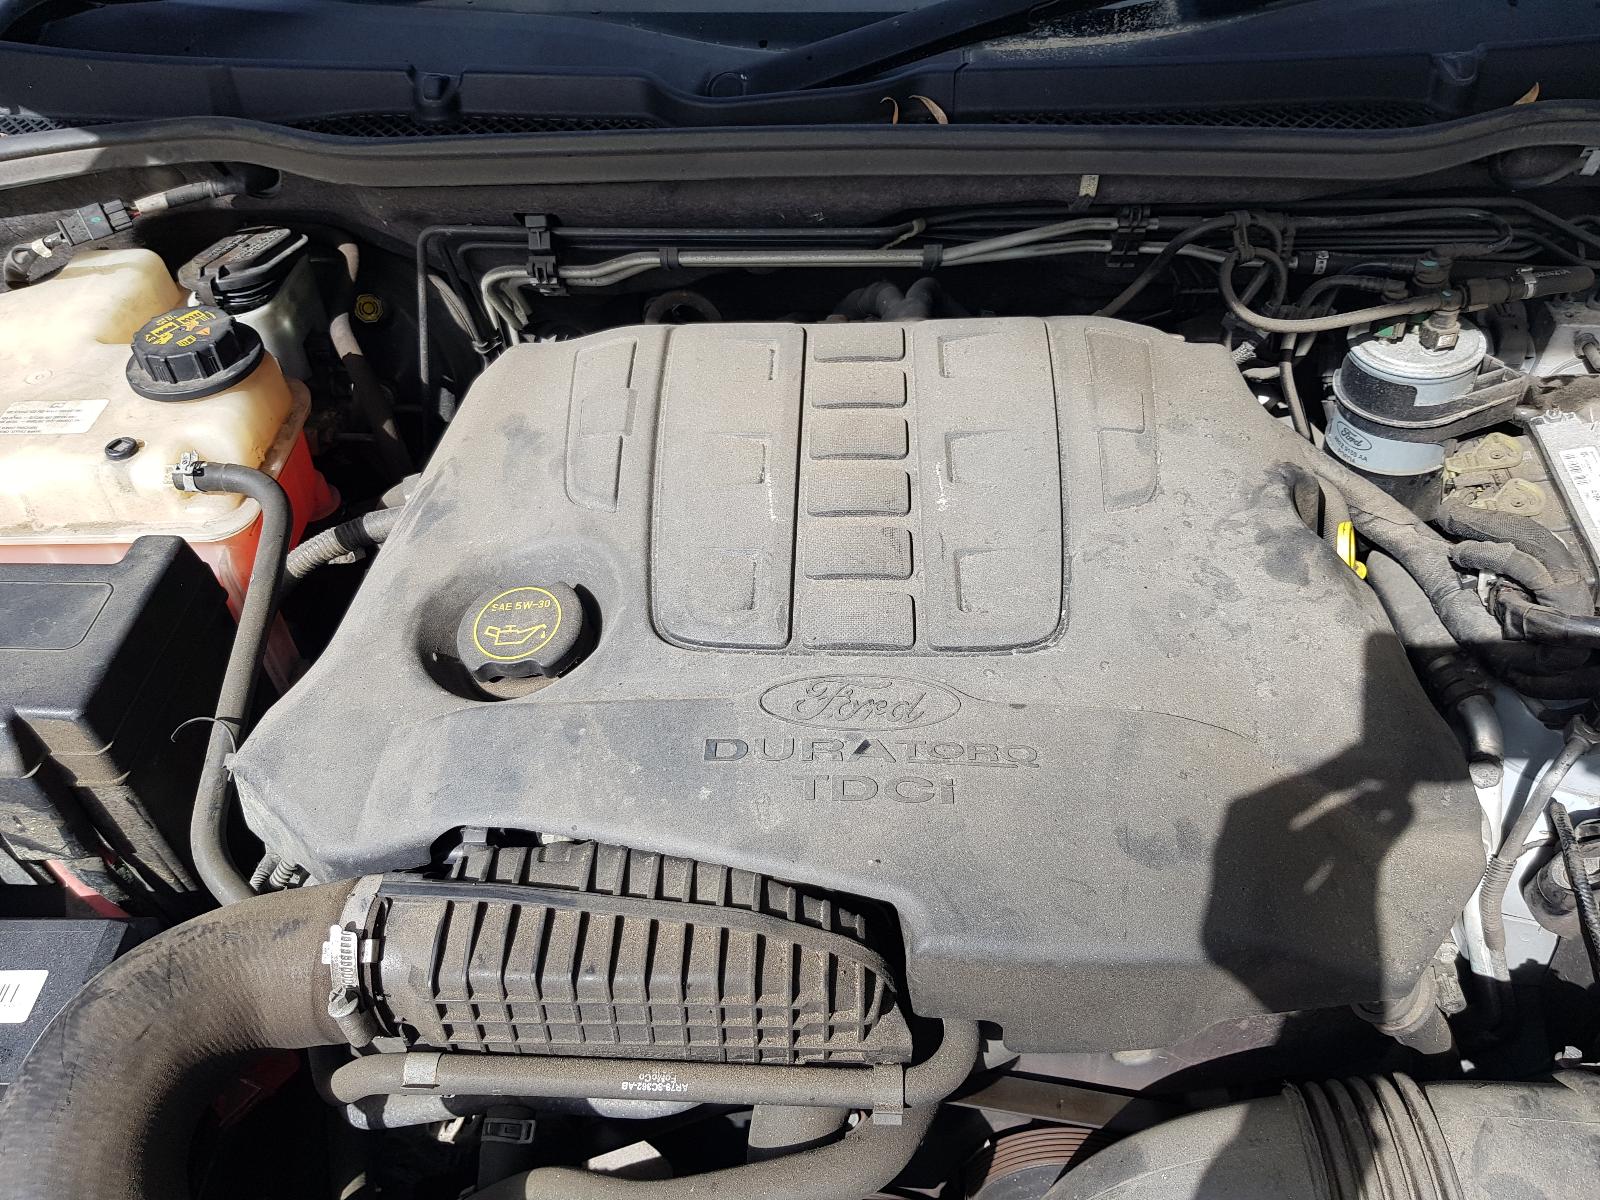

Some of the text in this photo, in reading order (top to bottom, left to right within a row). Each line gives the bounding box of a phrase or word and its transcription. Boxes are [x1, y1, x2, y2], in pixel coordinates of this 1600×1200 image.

[1341, 427, 1363, 446] Ford
[491, 600, 551, 612] SAE 5W-30
[796, 678, 927, 723] Ford
